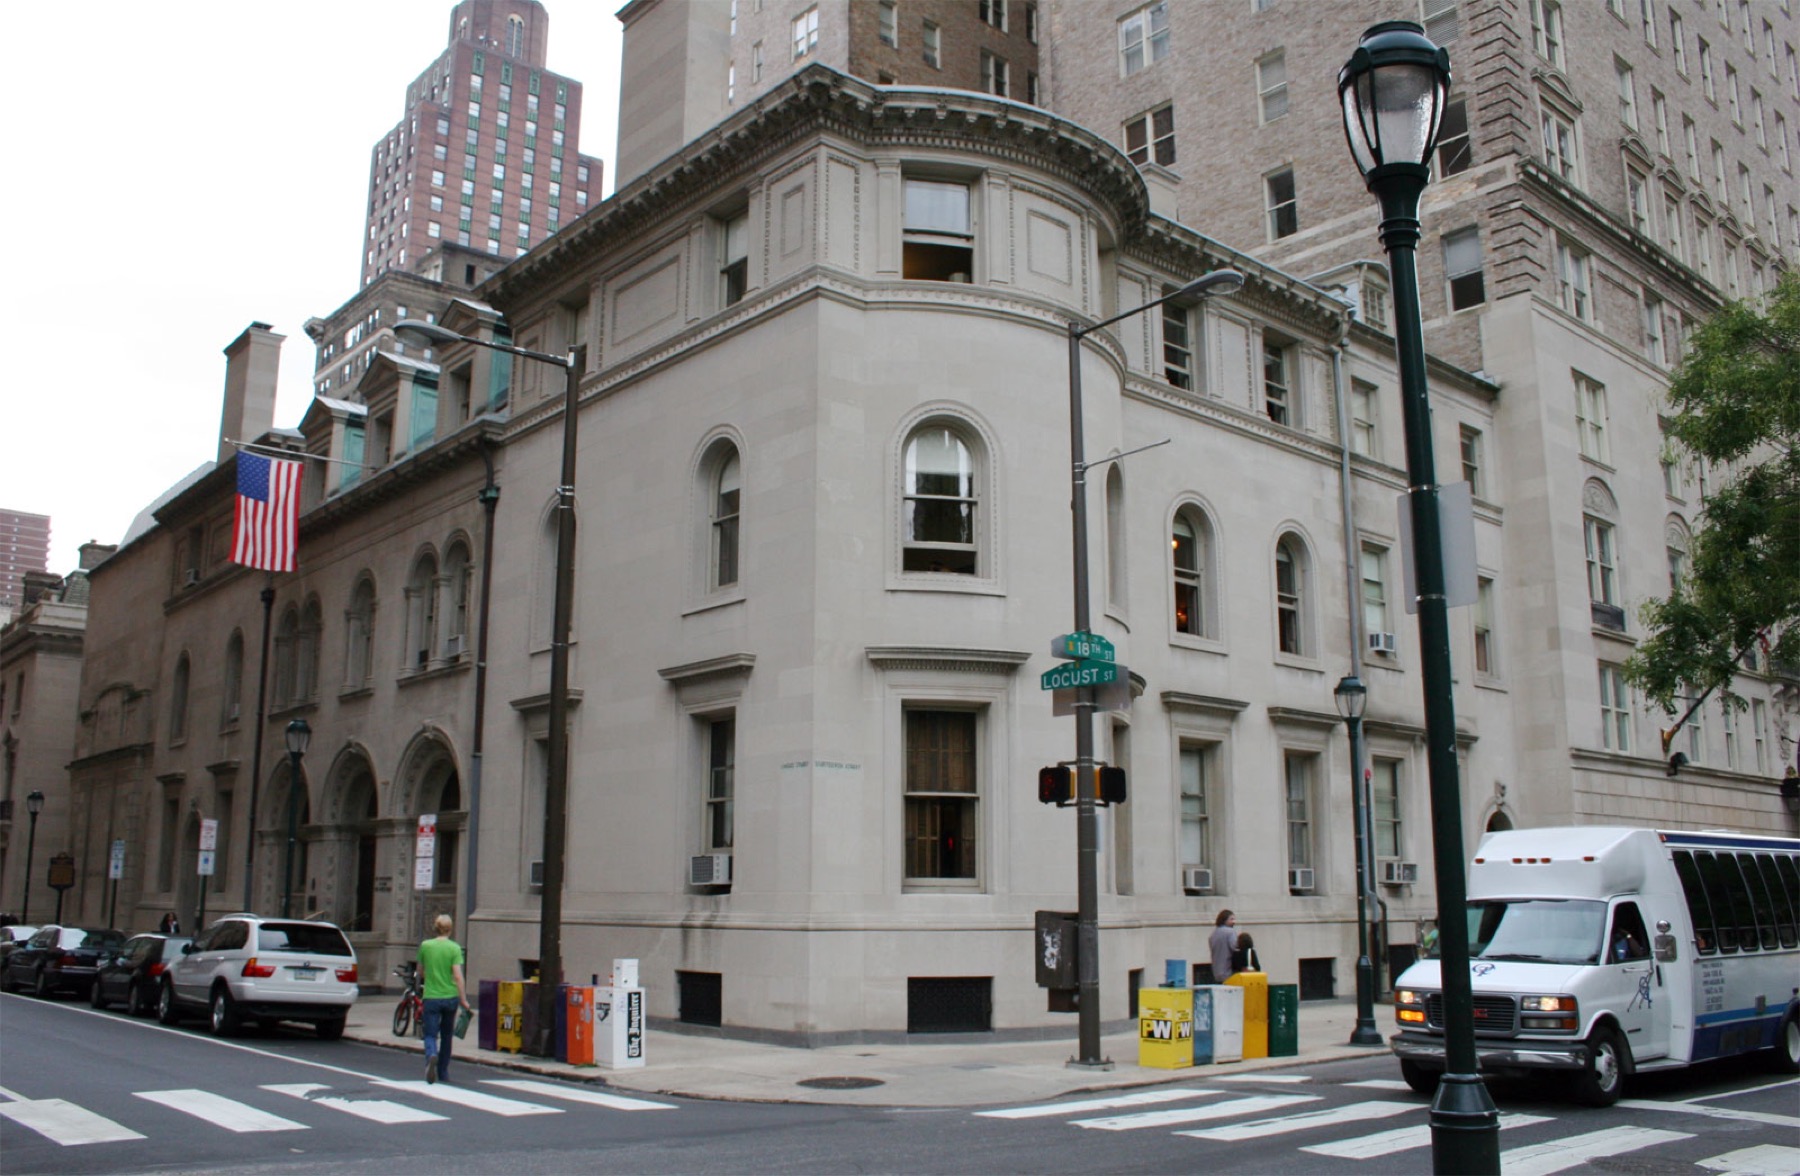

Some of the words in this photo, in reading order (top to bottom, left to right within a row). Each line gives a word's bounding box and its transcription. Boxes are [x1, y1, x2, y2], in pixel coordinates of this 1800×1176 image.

[1104, 650, 1113, 660] ST
[1043, 668, 1099, 689] LOCUST
[1104, 670, 1114, 681] ST
[1142, 1019, 1172, 1039] PW
[1176, 1021, 1191, 1039] PW
